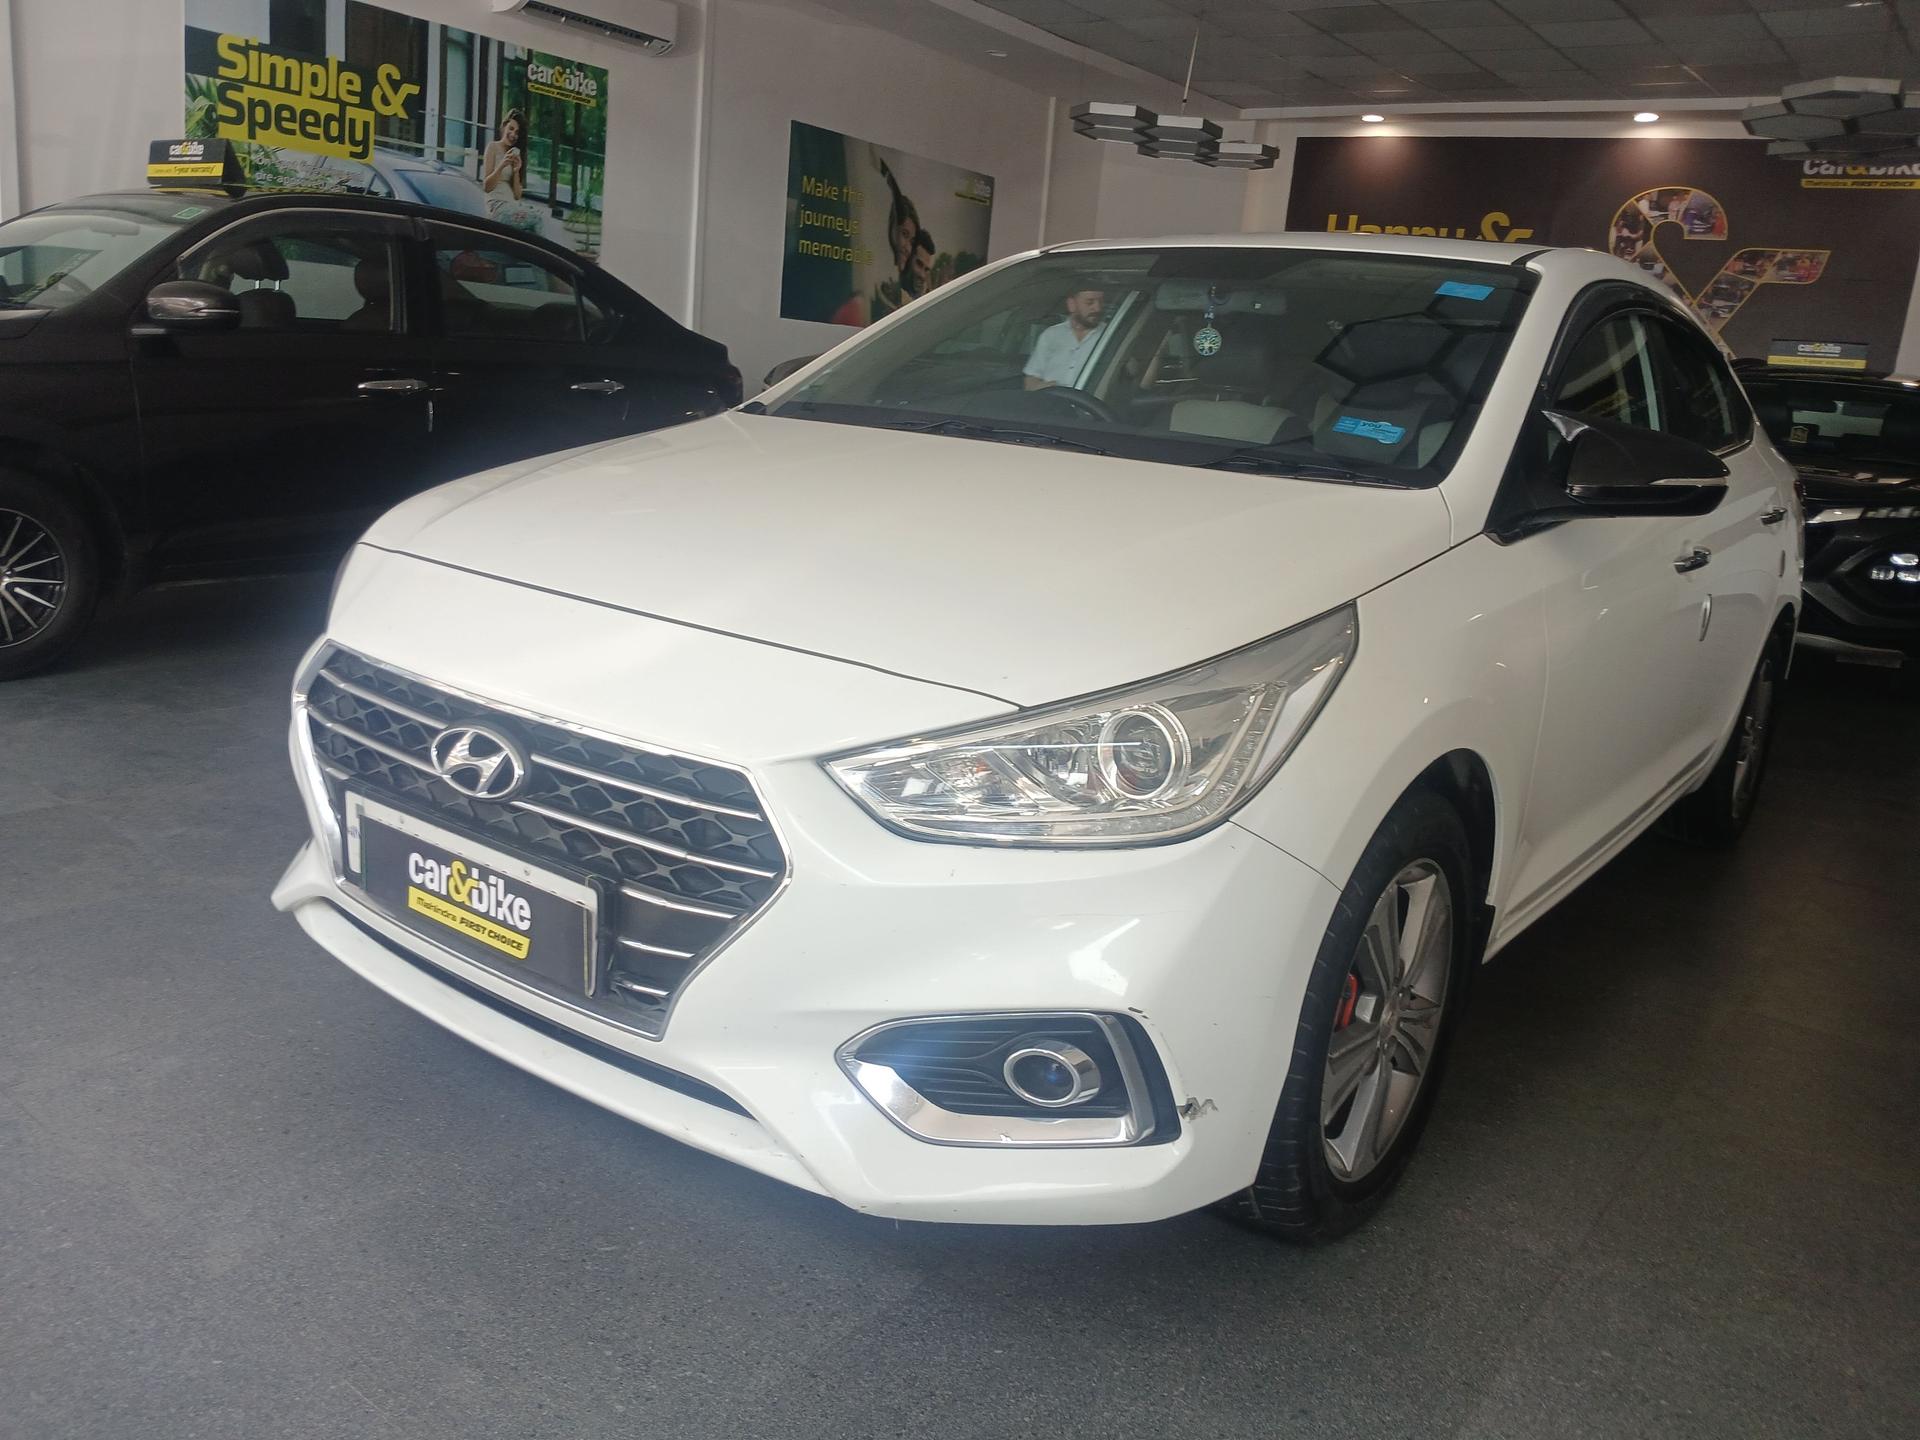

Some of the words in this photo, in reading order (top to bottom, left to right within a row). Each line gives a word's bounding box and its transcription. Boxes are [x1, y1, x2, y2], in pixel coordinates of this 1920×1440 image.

[217, 33, 362, 104] Simple
[371, 64, 420, 119] &
[527, 63, 597, 97] car&bike
[217, 82, 371, 160] Speedy
[801, 175, 839, 201] Make
[799, 203, 860, 238] journeys
[408, 852, 532, 931] car&bike
[459, 916, 487, 936] FIRST
[486, 928, 525, 952] CHOICE
